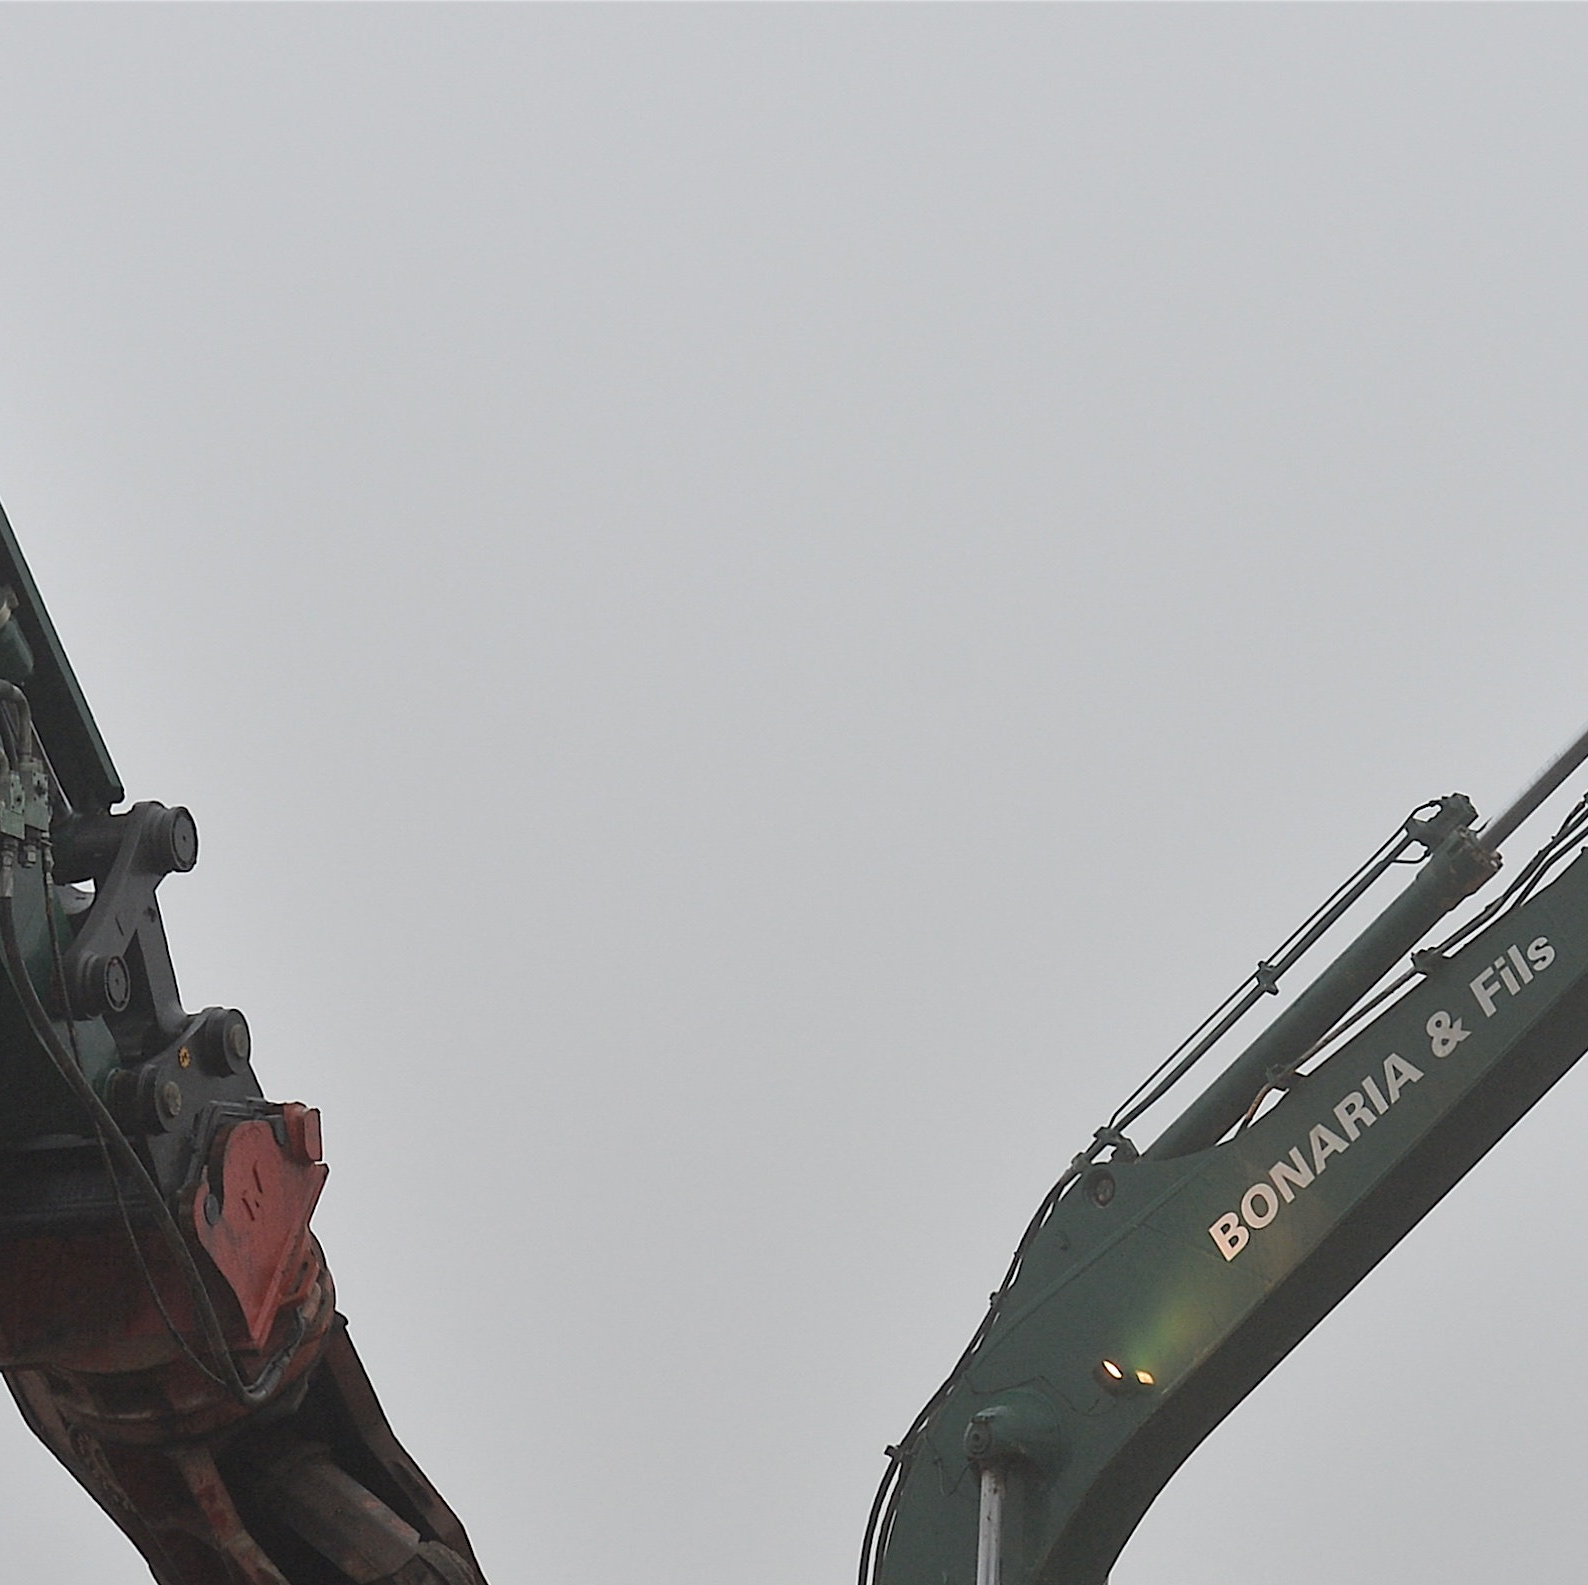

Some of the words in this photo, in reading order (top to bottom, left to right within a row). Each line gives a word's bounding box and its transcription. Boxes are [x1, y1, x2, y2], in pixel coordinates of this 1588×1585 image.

[1208, 1053, 1425, 1262] BONARIA
[1426, 1010, 1472, 1058] &
[1468, 936, 1556, 1018] Fils
